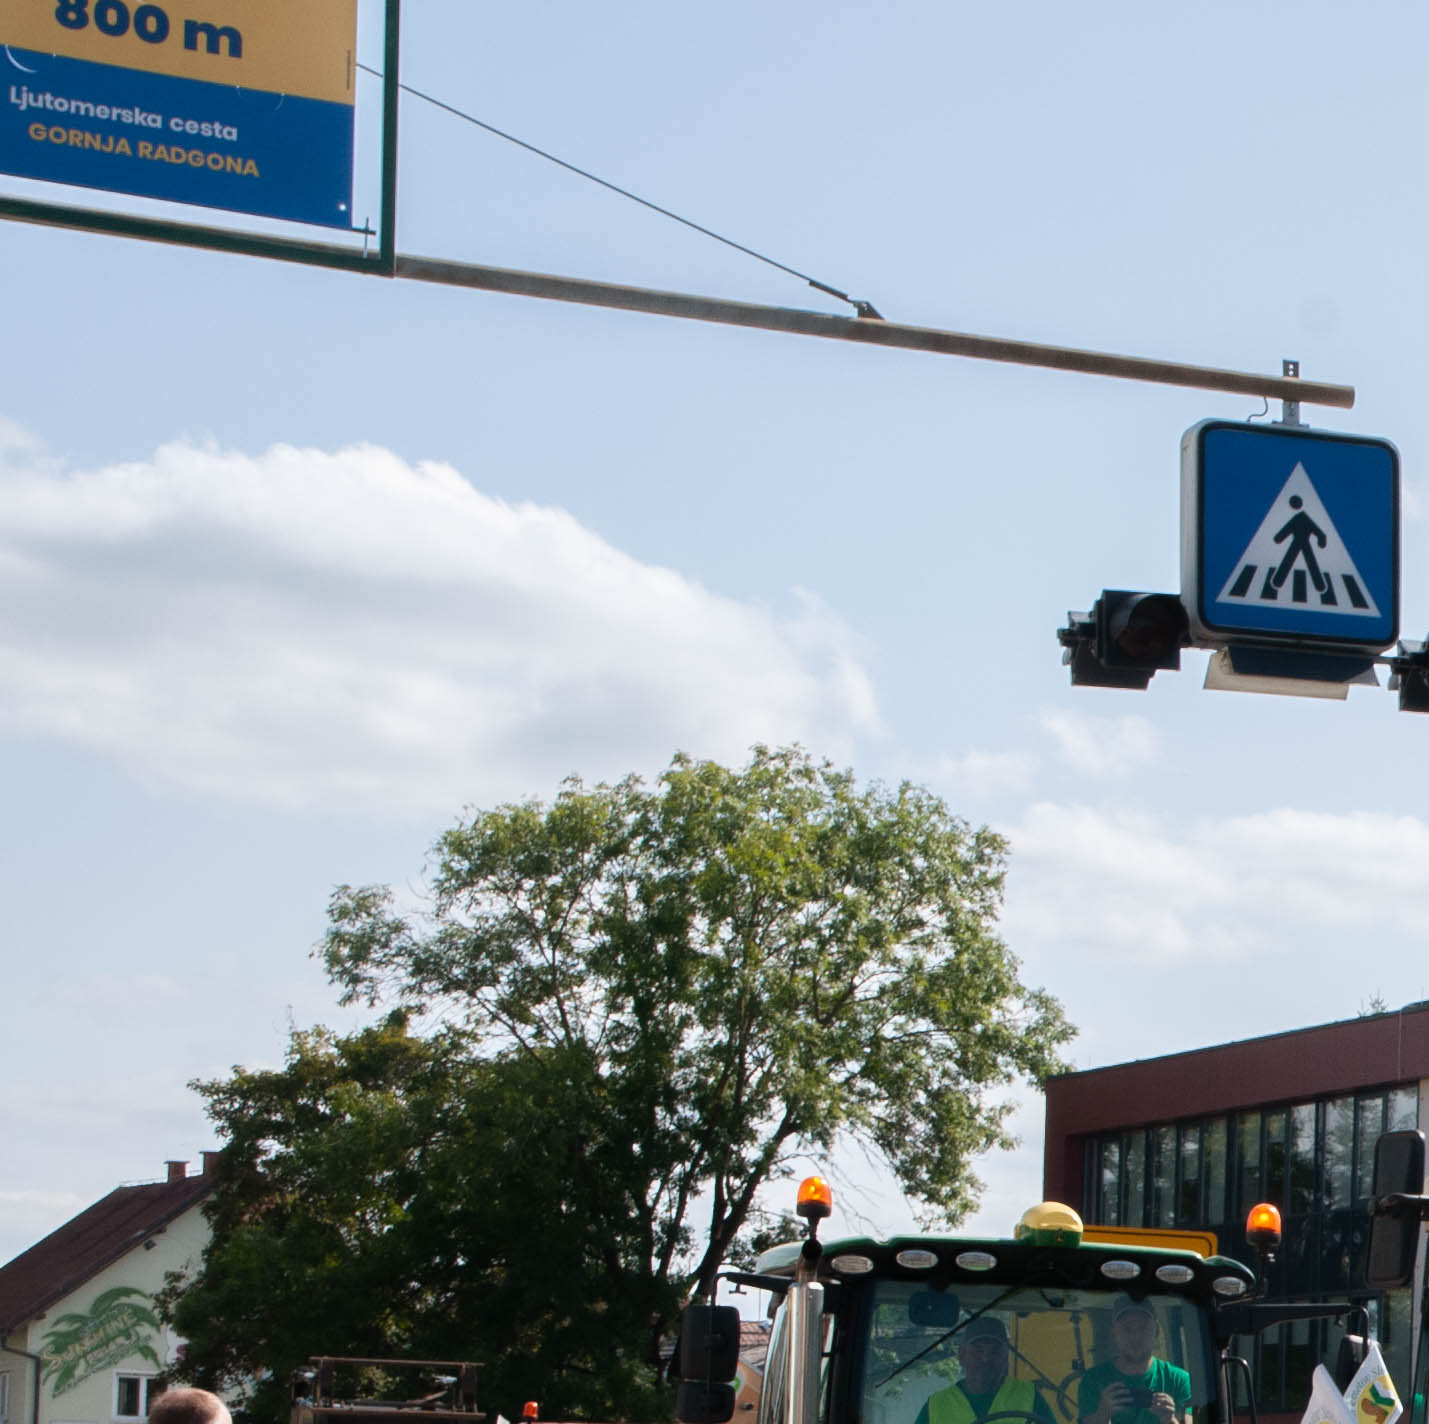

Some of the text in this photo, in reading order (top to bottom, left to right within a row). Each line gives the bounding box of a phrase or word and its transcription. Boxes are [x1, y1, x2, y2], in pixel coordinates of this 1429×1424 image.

[55, 0, 243, 59] 800 m
[9, 86, 238, 142] Ljutomerska cesta
[28, 123, 260, 177] GORNJA RADGONA
